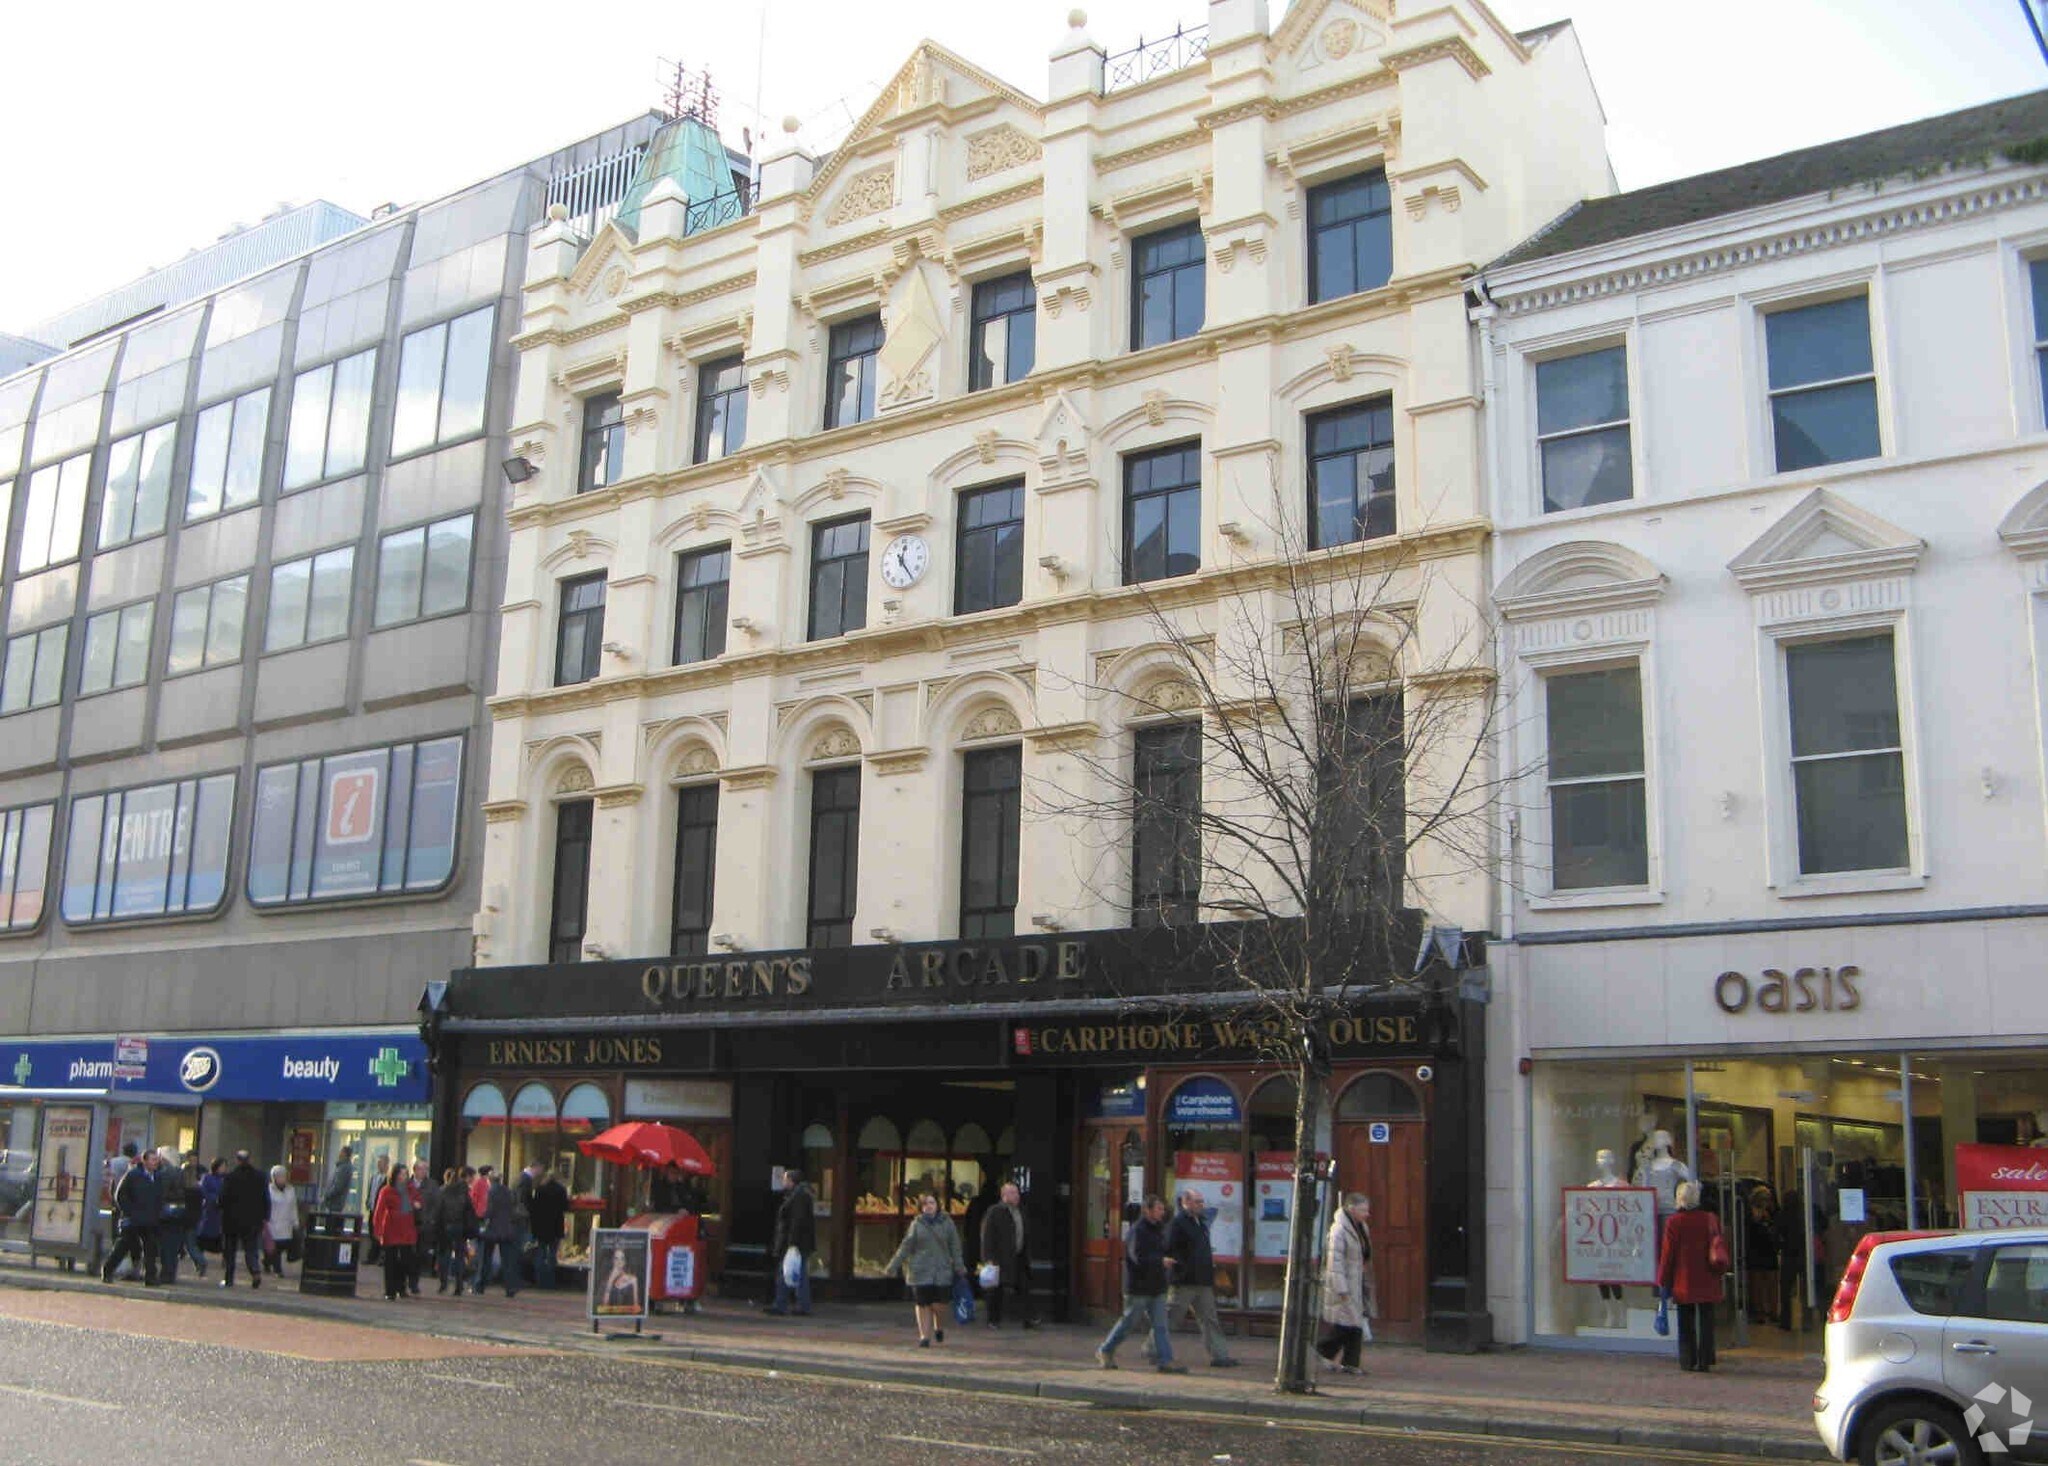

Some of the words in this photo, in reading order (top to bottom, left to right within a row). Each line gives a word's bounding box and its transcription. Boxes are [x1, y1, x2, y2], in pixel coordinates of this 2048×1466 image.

[105, 806, 189, 863] CENTRE
[641, 957, 812, 1004] QUEEN'S
[885, 941, 1087, 989] ARCADE
[1715, 965, 1861, 1013] oasis
[1040, 1024, 1200, 1052] CARPHONE
[1212, 1016, 1418, 1047] WAROUSE
[489, 1041, 576, 1065] ERNEST
[584, 1038, 663, 1064] JONES
[283, 1055, 340, 1083] beauty
[1181, 1095, 1233, 1107] Carphone
[1991, 1161, 2048, 1181] sale
[1575, 1197, 1643, 1213] EXTRA
